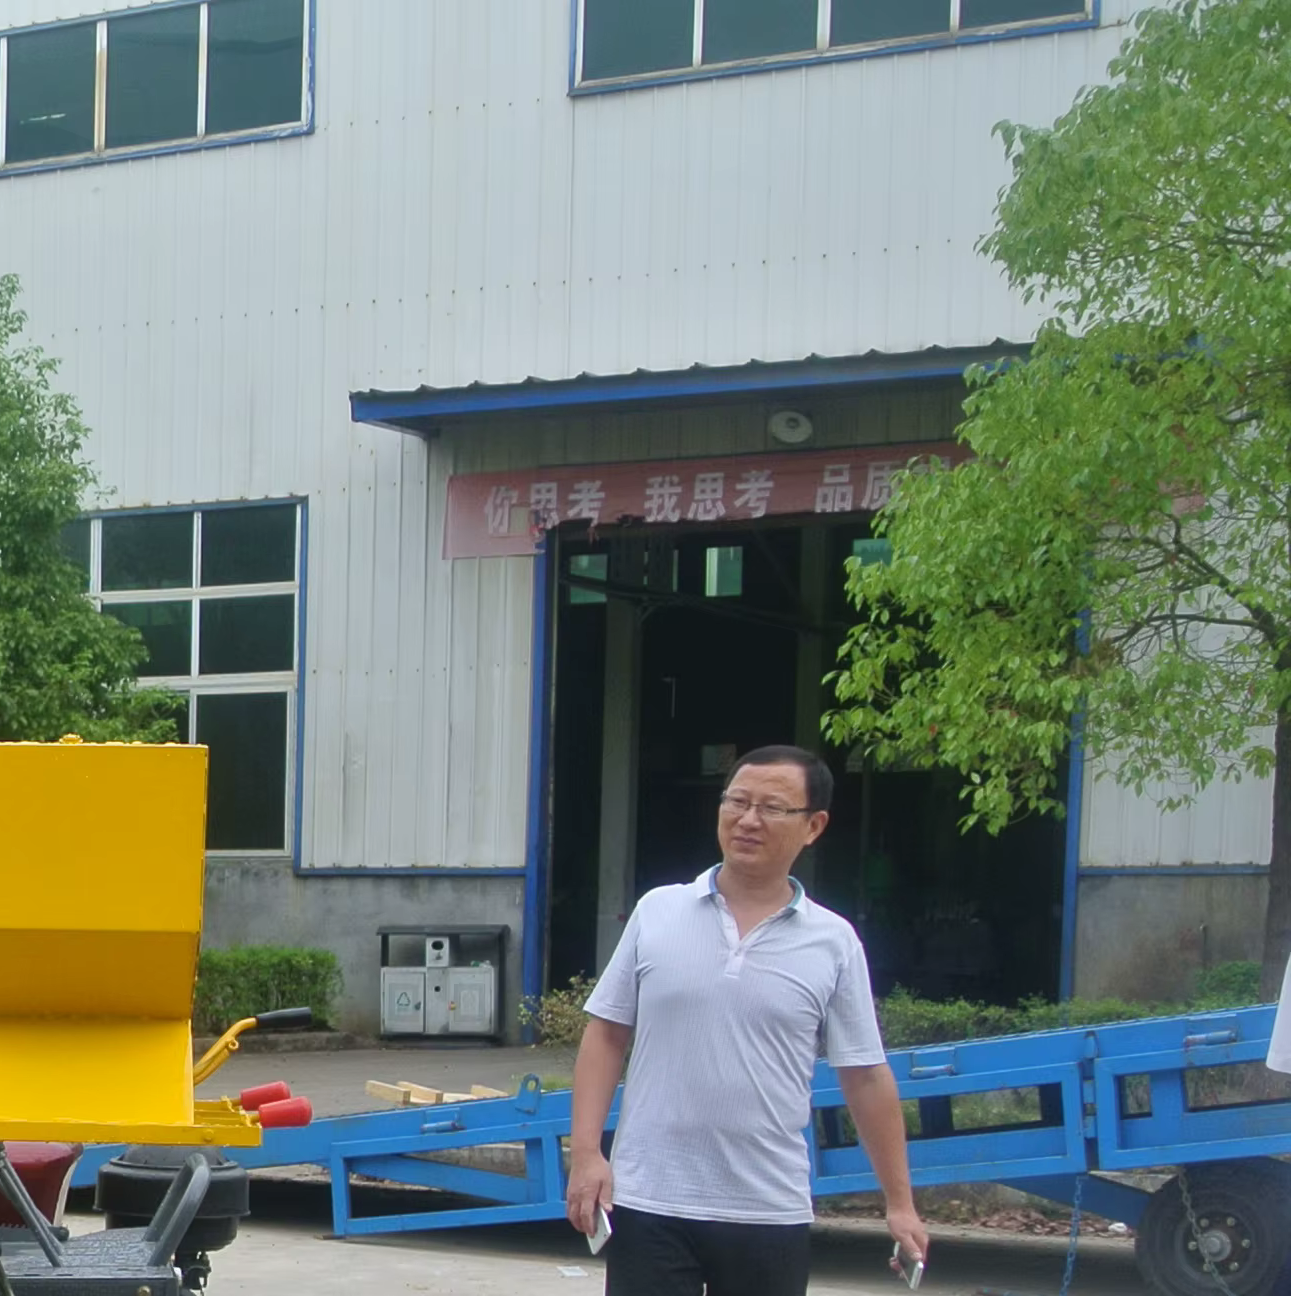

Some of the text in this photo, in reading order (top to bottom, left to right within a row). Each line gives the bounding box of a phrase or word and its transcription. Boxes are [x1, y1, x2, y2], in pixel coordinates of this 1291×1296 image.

[484, 480, 605, 534] 你思考
[644, 469, 774, 522] 我思考
